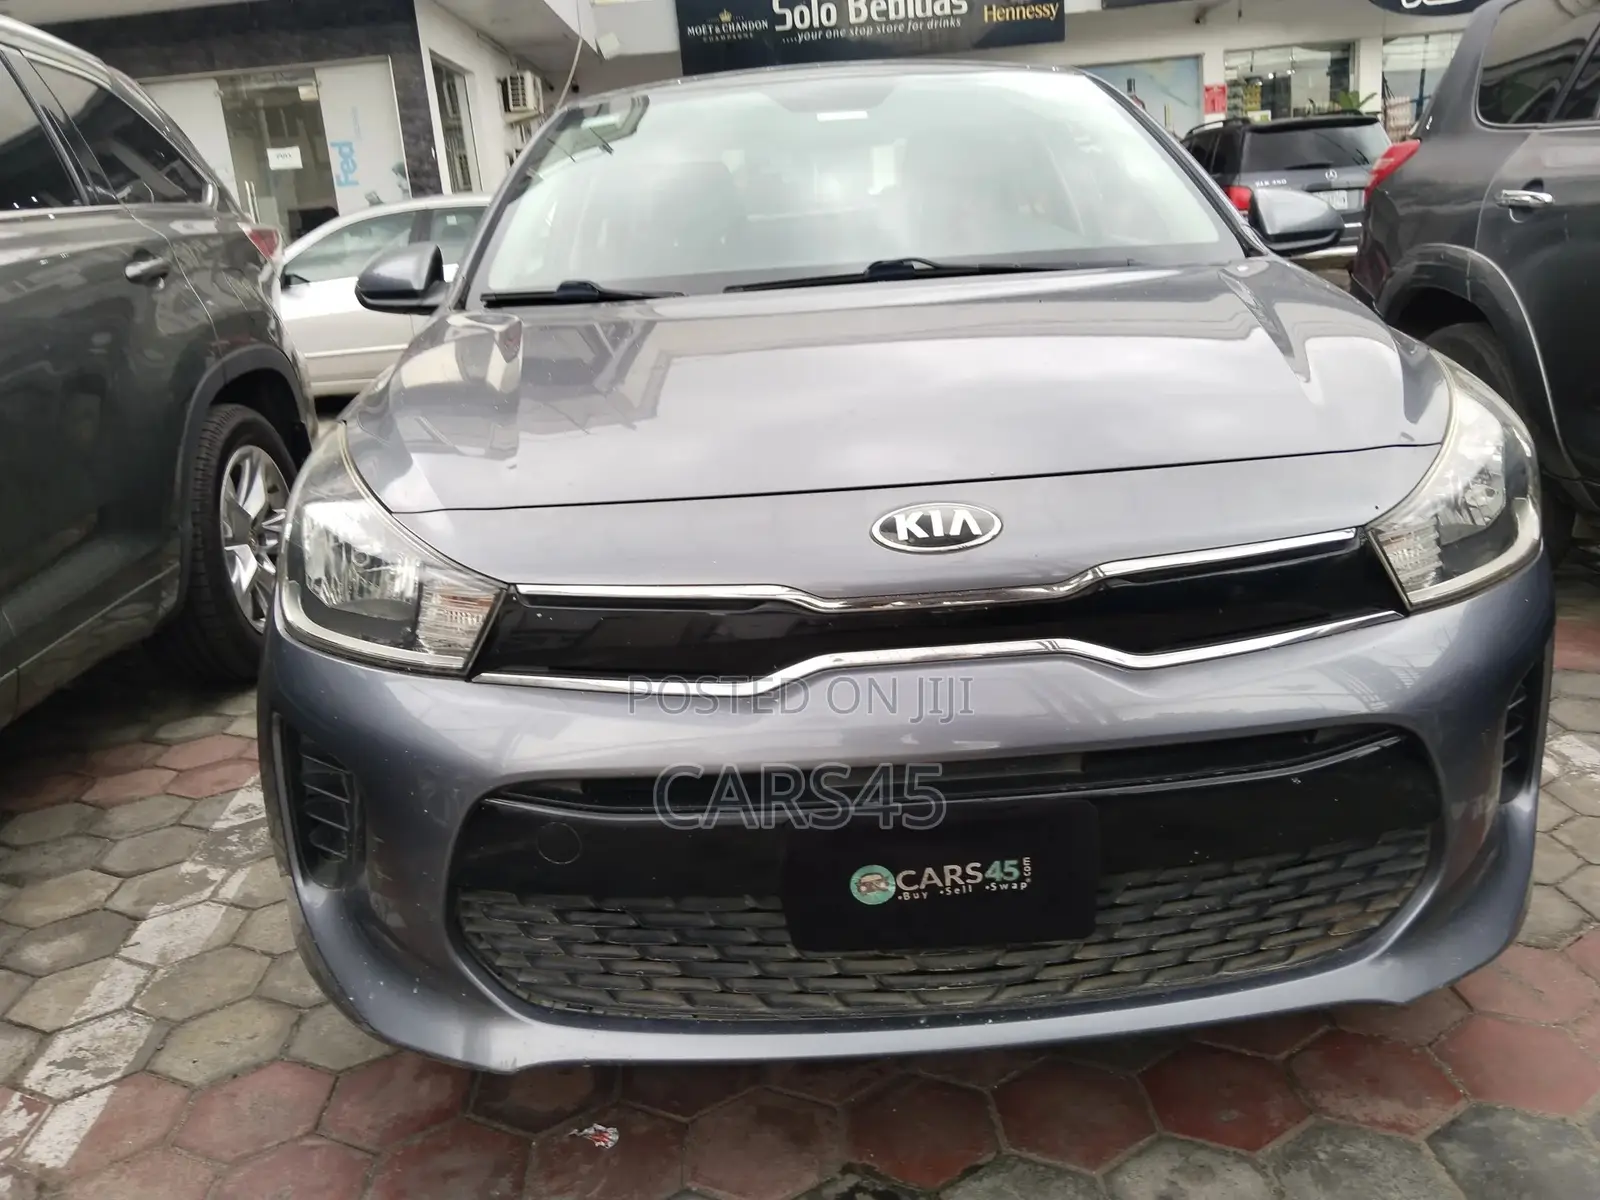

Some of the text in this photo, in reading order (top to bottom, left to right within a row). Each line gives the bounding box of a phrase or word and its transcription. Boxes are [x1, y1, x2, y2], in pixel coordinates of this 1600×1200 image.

[721, 19, 769, 34] CHANDON
[772, 0, 838, 31] Solo
[983, 2, 1060, 24] Hennessy
[825, 28, 847, 40] one
[849, 26, 873, 37] stop
[876, 23, 905, 34] store
[906, 20, 925, 34] for
[926, 16, 962, 30] drinks
[893, 509, 983, 541] KIA
[896, 860, 1020, 891] CARS45
